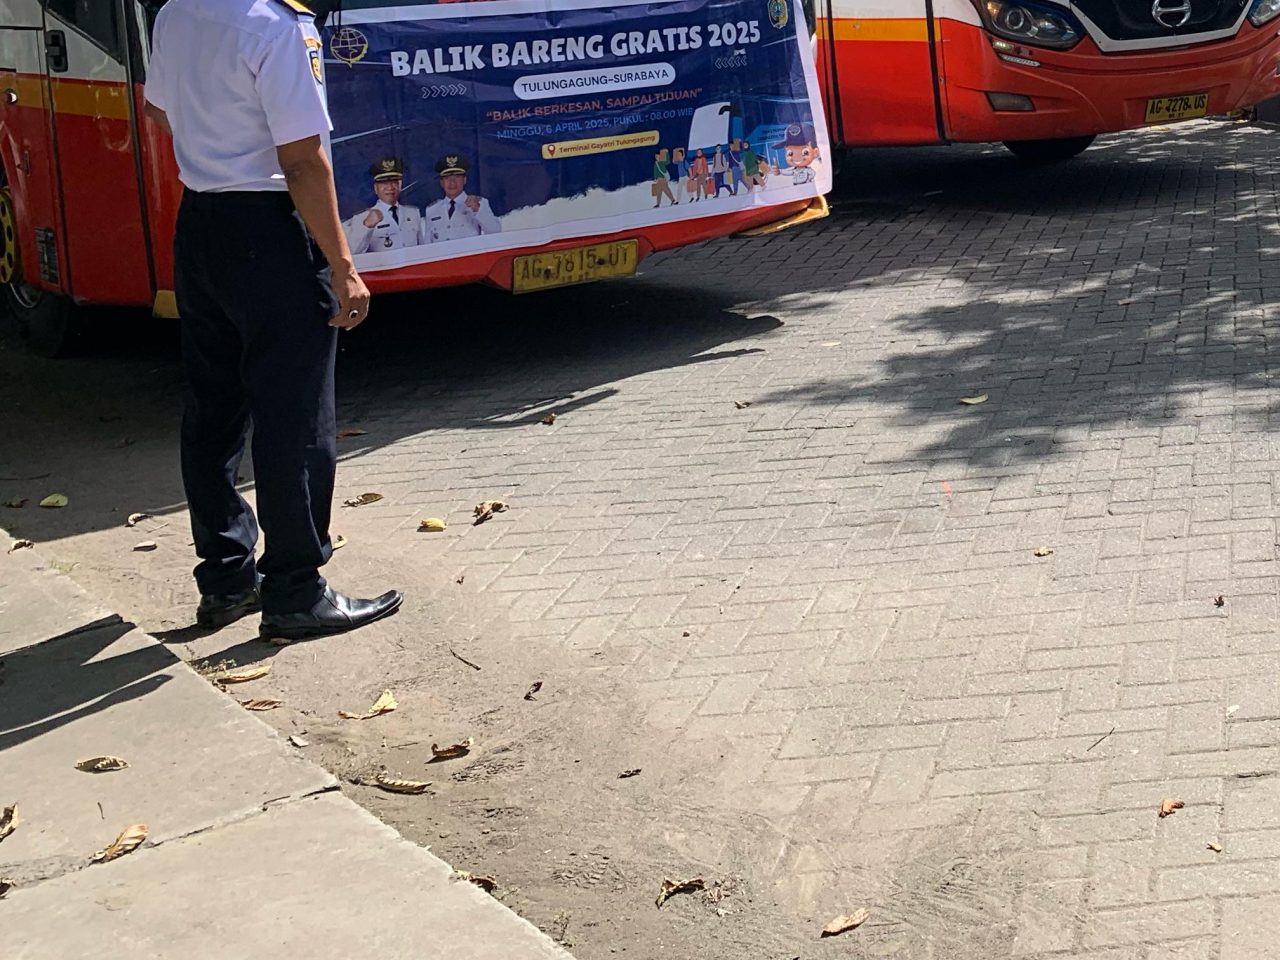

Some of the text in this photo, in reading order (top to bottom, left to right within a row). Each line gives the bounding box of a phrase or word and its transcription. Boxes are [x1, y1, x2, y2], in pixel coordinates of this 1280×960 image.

[390, 20, 761, 78] BALIK BARENG GRATIS 2025
[606, 93, 651, 110] SAMPAI
[1149, 99, 1163, 114] AG
[1193, 95, 1207, 109] US
[546, 123, 553, 135] 6
[555, 120, 582, 133] APRIL
[613, 114, 644, 127] PUKUL
[649, 110, 676, 122] 08.00
[677, 106, 694, 118] WIB
[559, 134, 656, 154] Terminal Gayatri Tulungagung
[521, 242, 629, 281] AG 7815 UT
